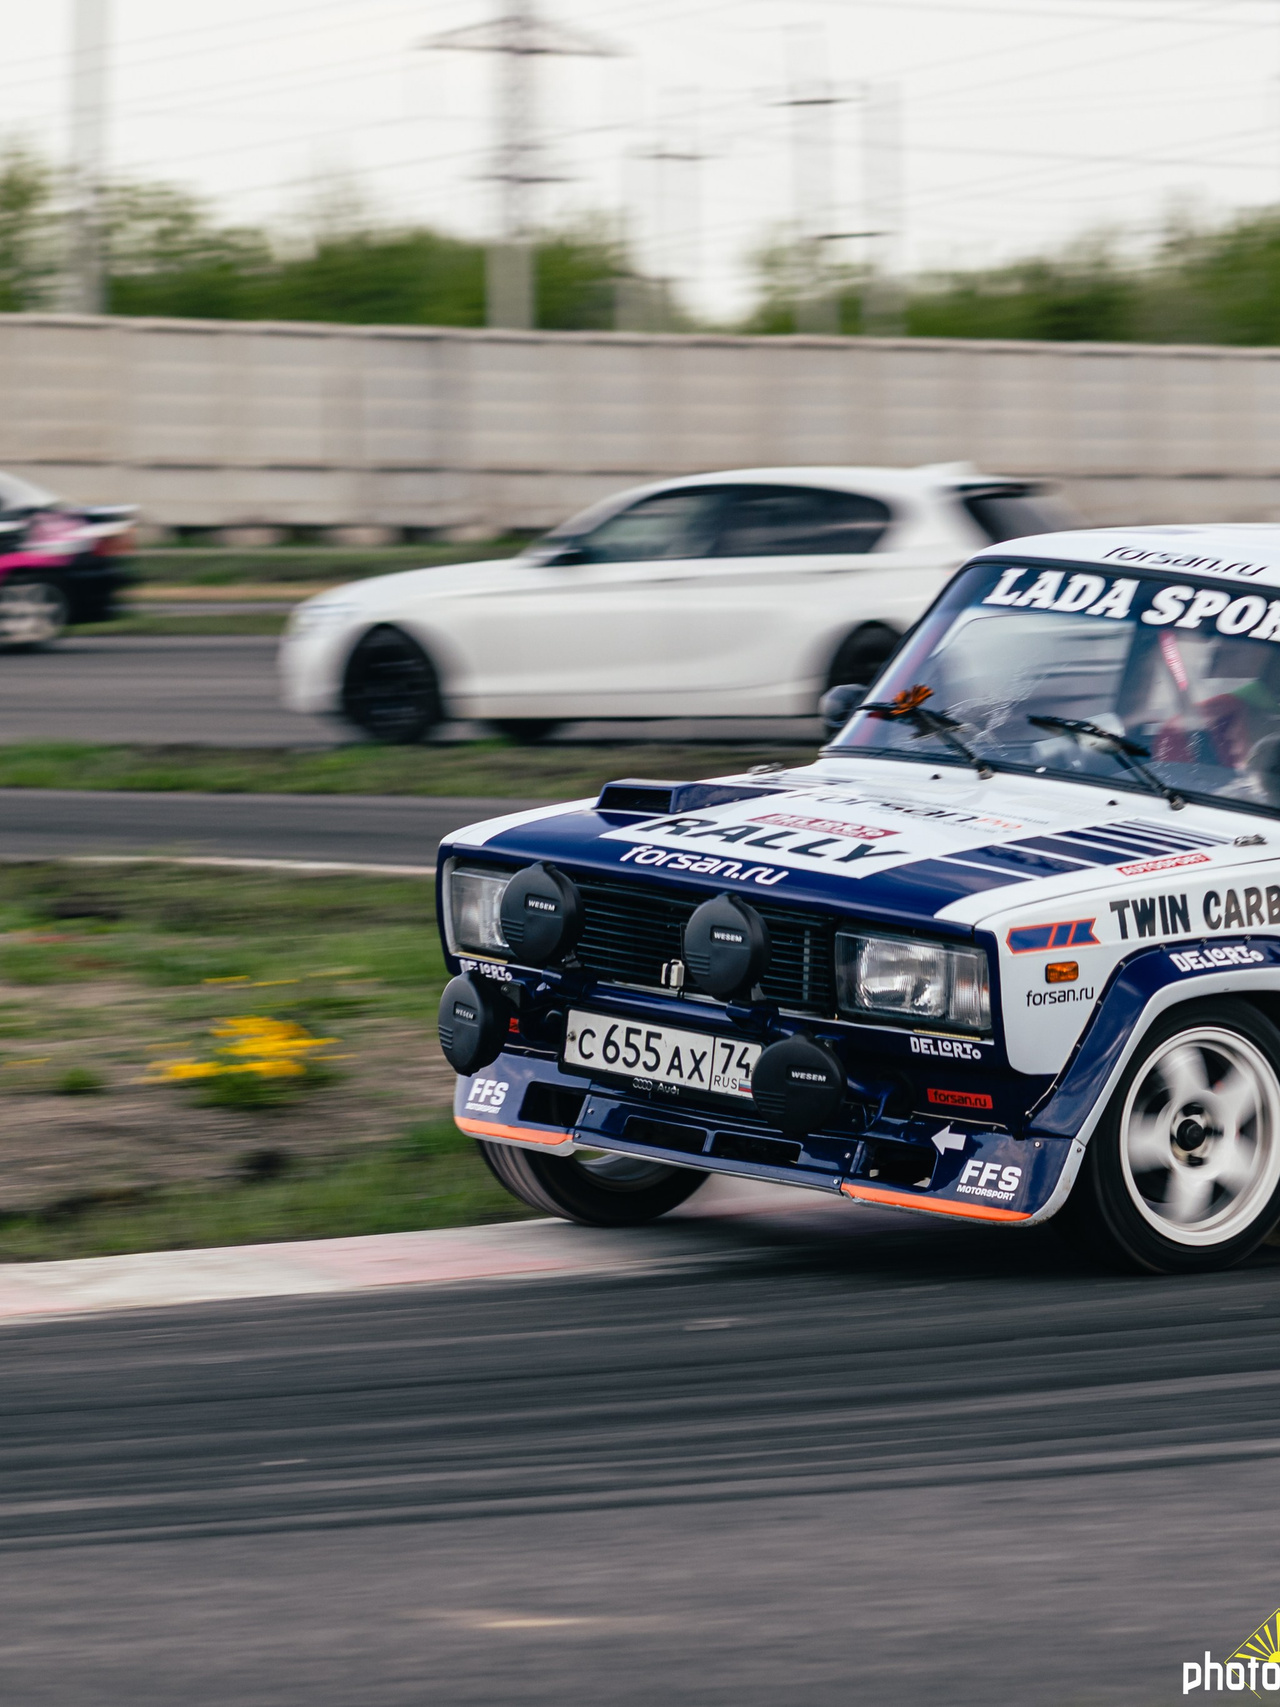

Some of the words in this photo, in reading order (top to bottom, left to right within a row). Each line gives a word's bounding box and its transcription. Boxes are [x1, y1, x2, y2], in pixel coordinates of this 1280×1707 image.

[981, 567, 1141, 619] LADA
[636, 817, 911, 863] RALLY
[619, 844, 790, 886] forsan.ru
[527, 899, 556, 912] WESEM
[1109, 893, 1191, 940] TWIN
[713, 931, 743, 944] WESEM
[1026, 986, 1095, 1007] forsan.ru
[454, 1008, 475, 1021] WESEM
[910, 1036, 982, 1060] DELLORTO
[719, 1042, 751, 1079] 74
[713, 1074, 738, 1090] RUS
[790, 1070, 827, 1083] WESEM
[467, 1078, 510, 1106] FFS
[656, 1082, 680, 1096] Audi
[932, 1090, 989, 1108] forsan.ru
[960, 1159, 1023, 1193] FFS
[956, 1184, 1016, 1201] MOTORSPORT
